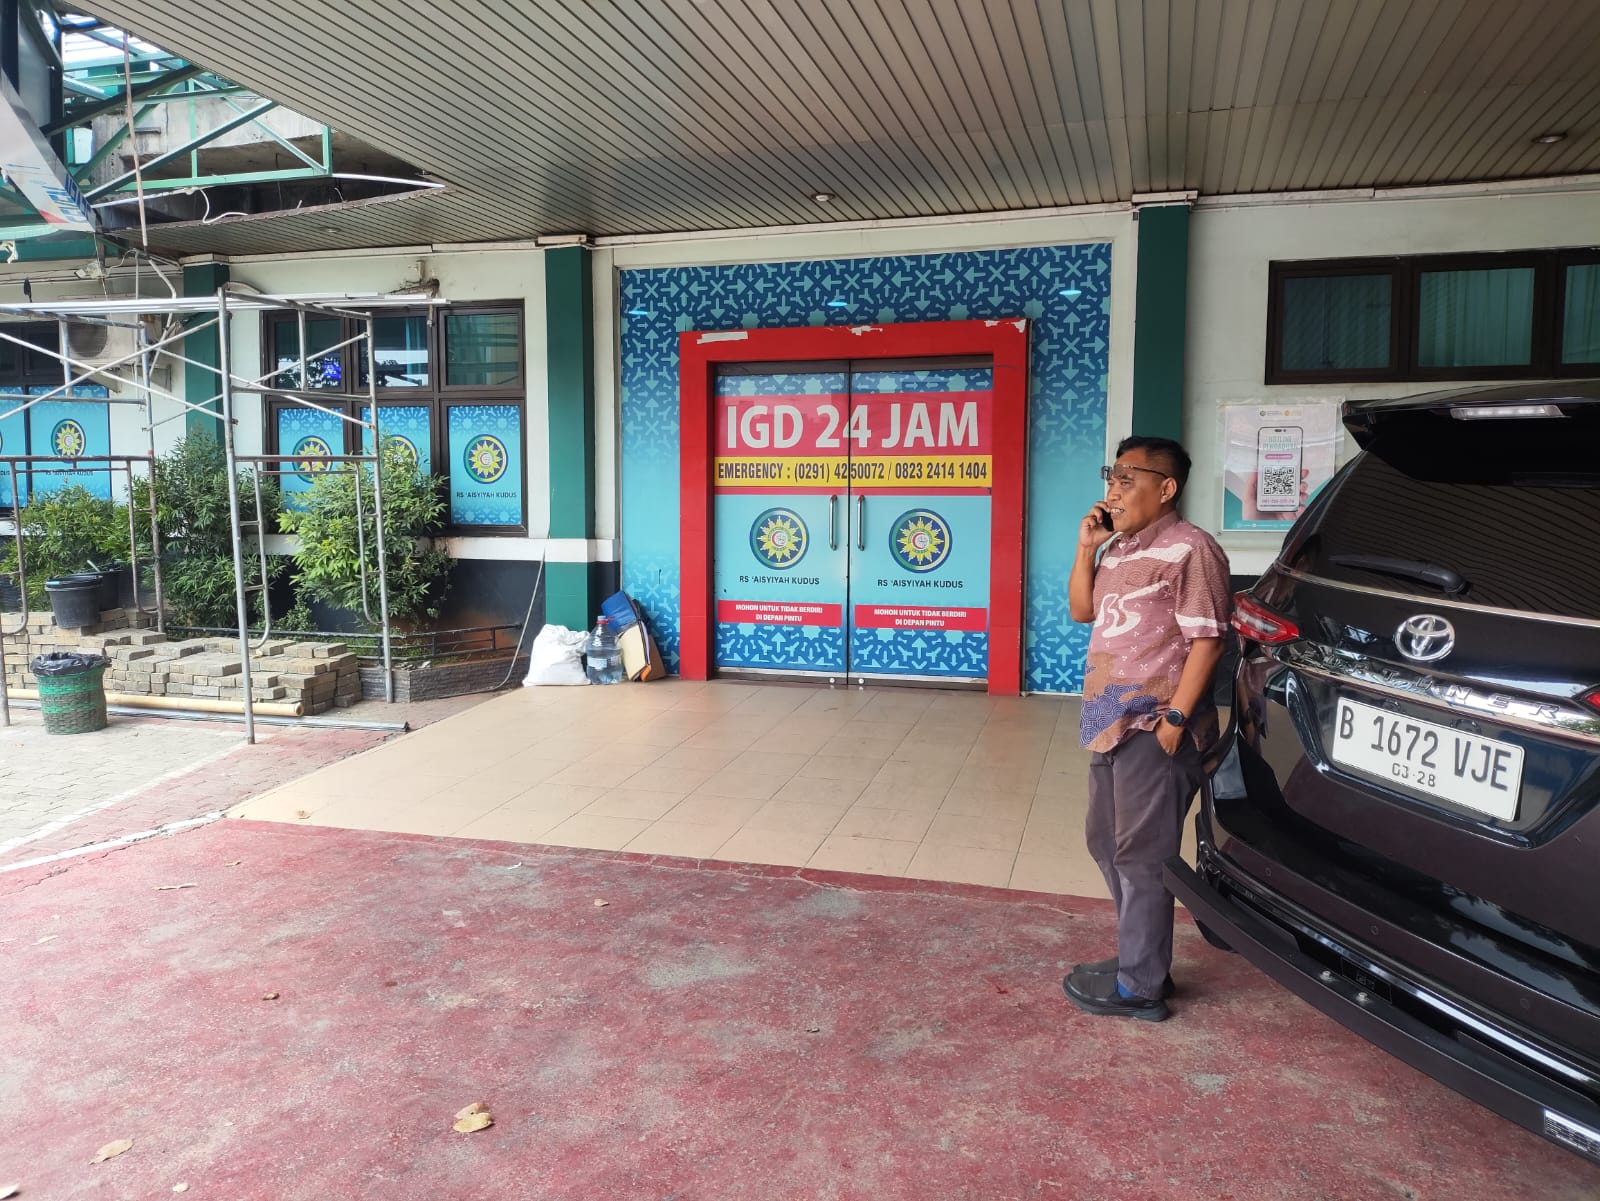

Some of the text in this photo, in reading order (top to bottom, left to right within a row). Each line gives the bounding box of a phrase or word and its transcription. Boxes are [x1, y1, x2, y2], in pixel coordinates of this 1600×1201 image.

[727, 401, 979, 448] IGD 24 JAM
[718, 462, 784, 479] EMERGENCY
[794, 462, 830, 482] (0291)
[834, 462, 885, 480] 4250072
[895, 462, 923, 479] 0823
[926, 462, 955, 479] 2414
[959, 462, 987, 479] 1404
[739, 575, 749, 583] RS
[791, 576, 820, 585] KUDUS
[877, 579, 888, 587] RS
[933, 580, 964, 589] KUDUS
[903, 618, 925, 626] DEPAN
[925, 619, 945, 627] PINTU
[1339, 704, 1512, 791] B 1672 VJE
